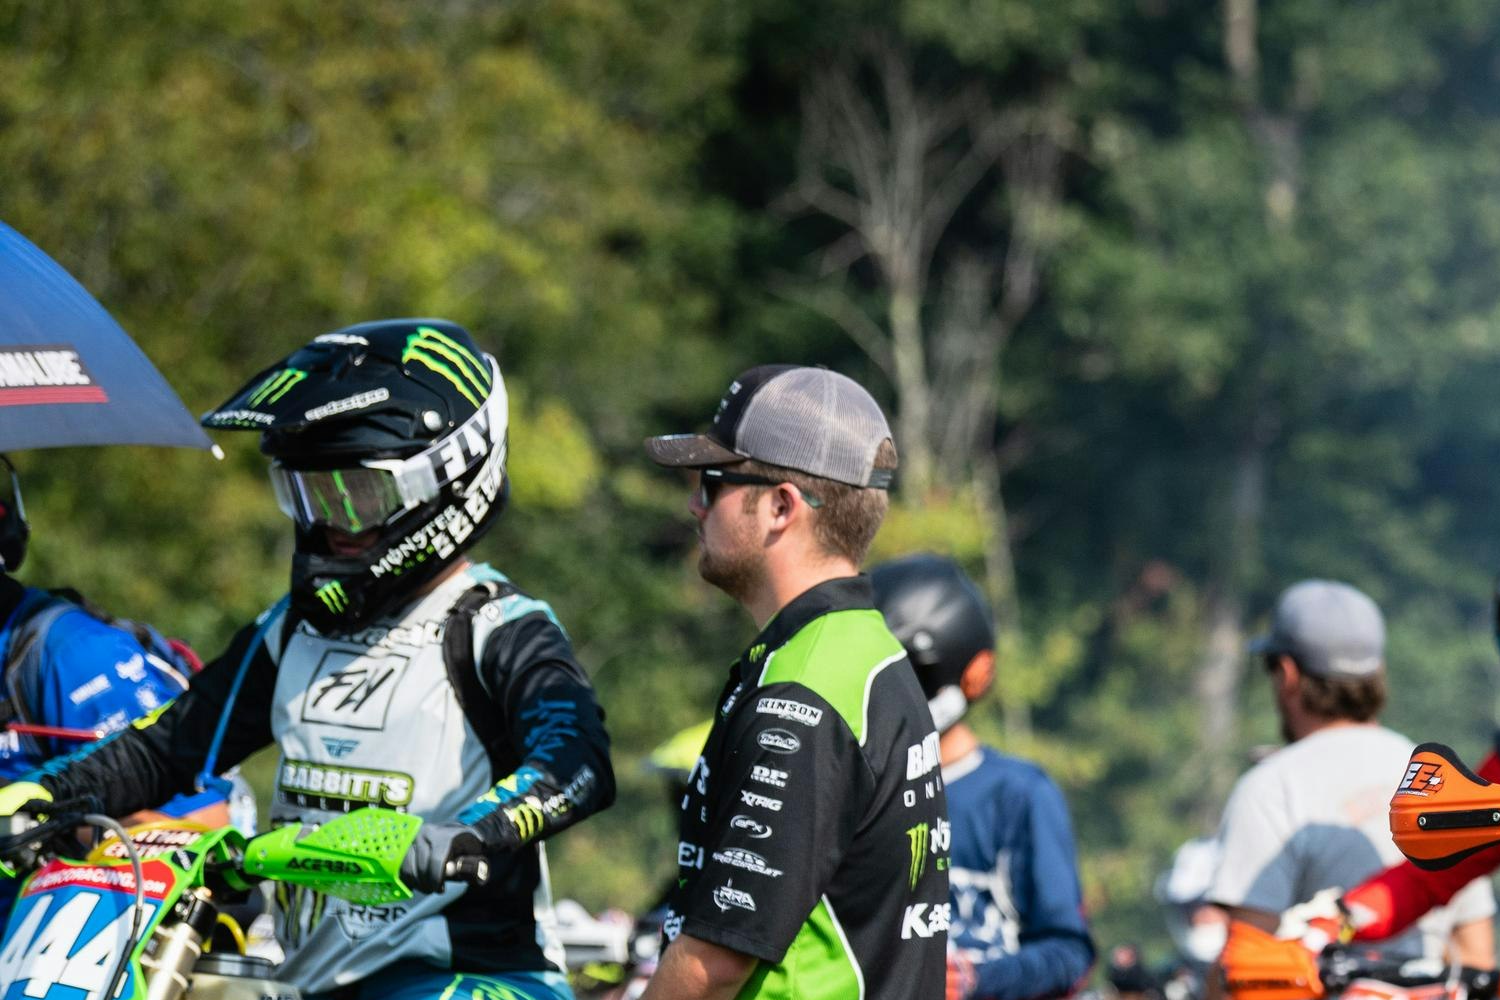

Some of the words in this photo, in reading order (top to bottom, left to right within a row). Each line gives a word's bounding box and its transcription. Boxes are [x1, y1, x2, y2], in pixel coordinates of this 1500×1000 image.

[418, 405, 494, 490] FLY
[369, 504, 461, 578] MONSTER
[281, 763, 409, 804] BABBITT'S
[285, 856, 363, 876] ACERBIS
